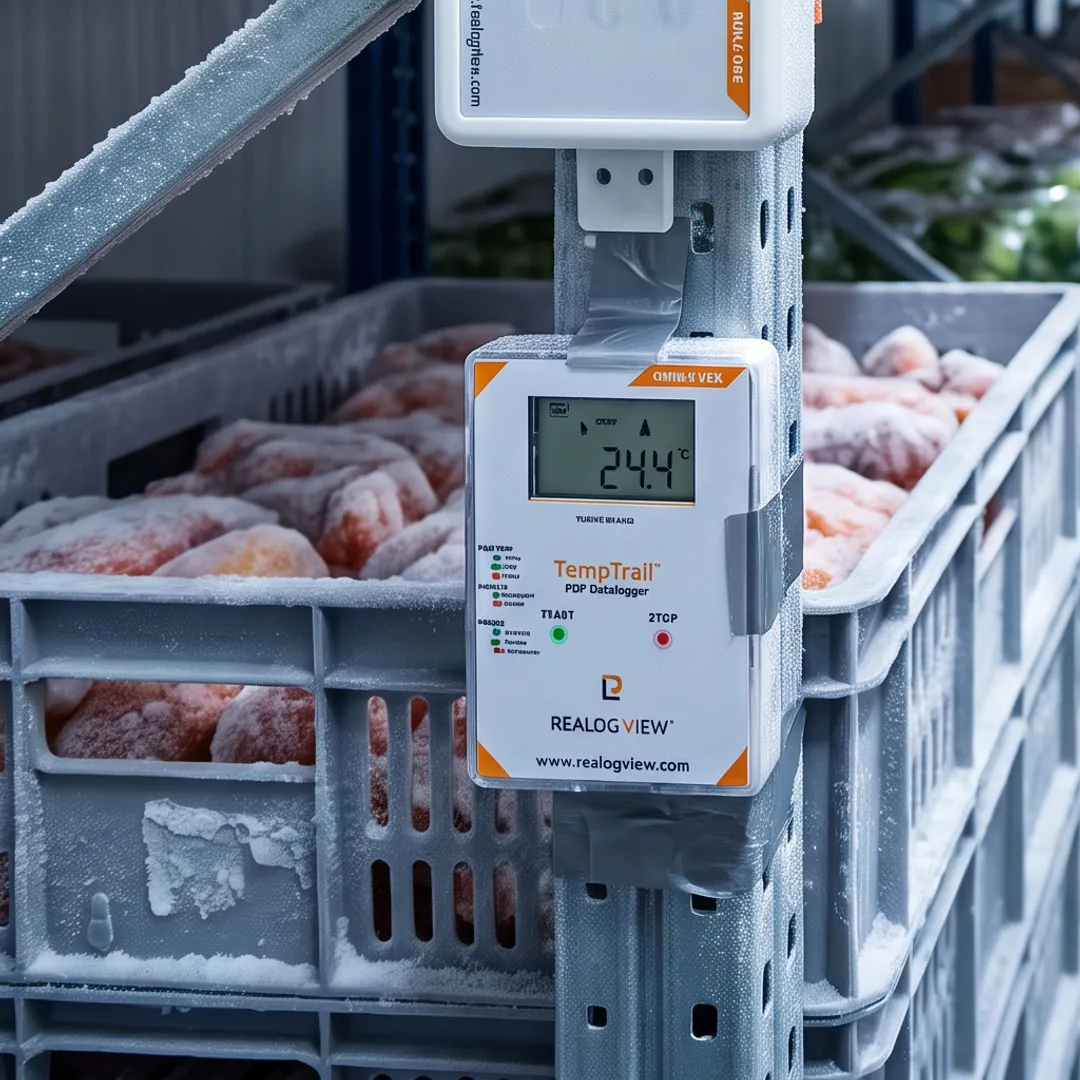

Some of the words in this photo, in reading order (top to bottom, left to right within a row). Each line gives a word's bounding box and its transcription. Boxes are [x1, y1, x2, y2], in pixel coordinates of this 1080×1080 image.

[600, 446, 673, 490] 24.4
[565, 583, 587, 593] PDP
[589, 584, 650, 598] Datalogger
[550, 716, 619, 734] REALOG
[621, 718, 669, 735] VIEW
[536, 754, 690, 773] www.realogview.com
